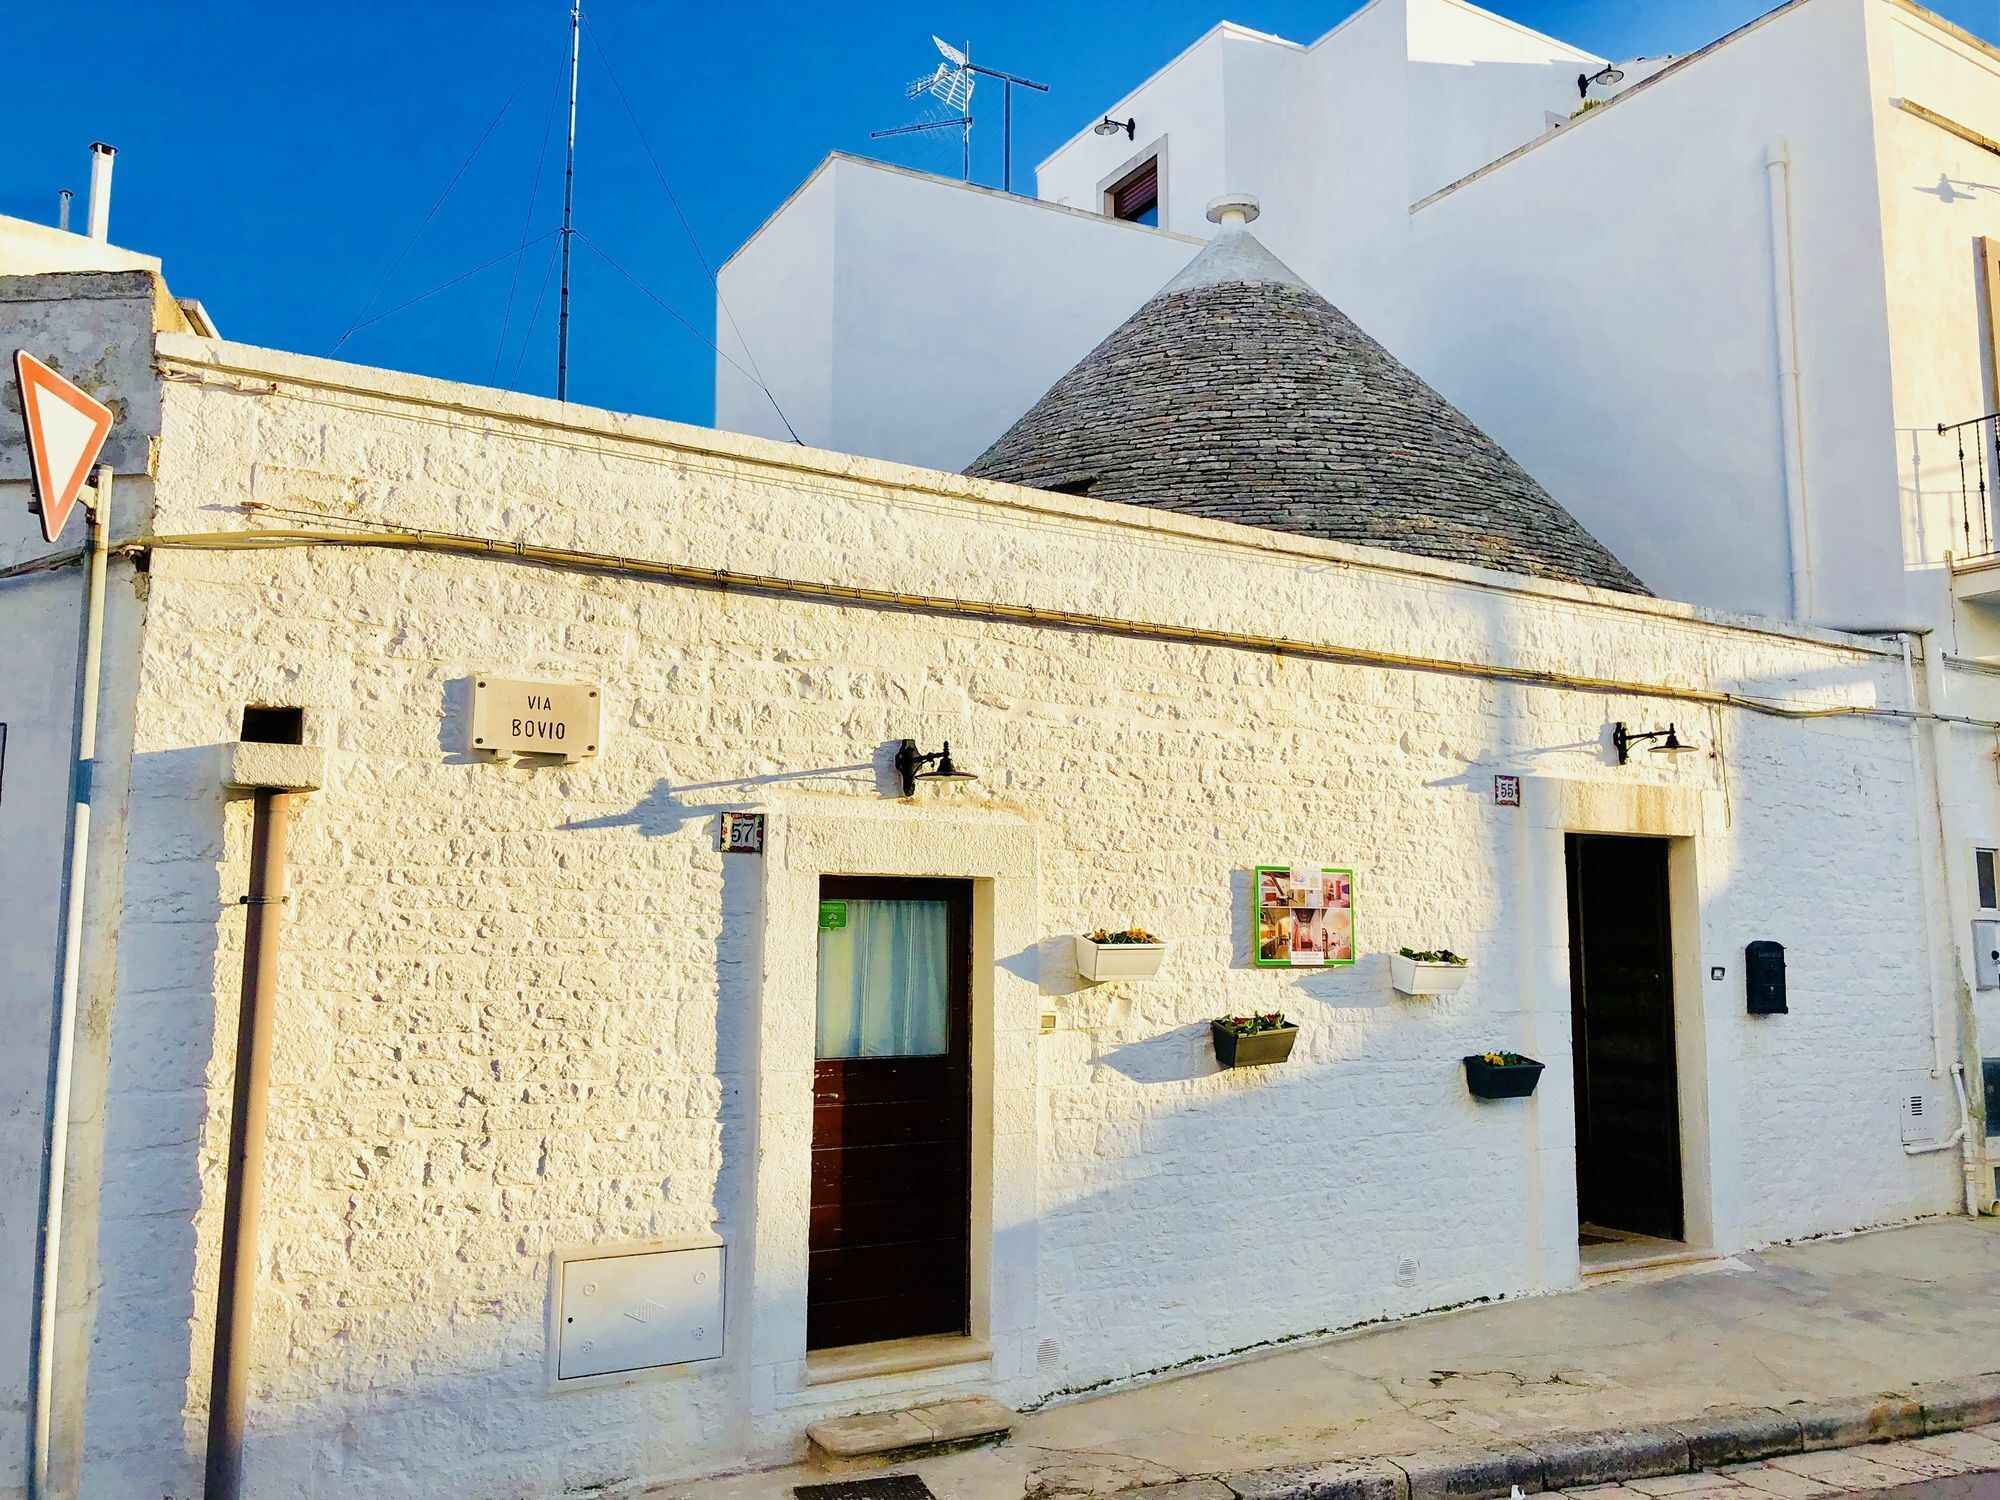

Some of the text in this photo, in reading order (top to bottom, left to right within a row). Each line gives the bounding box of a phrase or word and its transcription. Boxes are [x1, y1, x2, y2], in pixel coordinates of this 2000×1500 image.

[527, 695, 552, 711] VIA
[512, 719, 566, 740] BOVIO
[1500, 782, 1514, 798] 55
[731, 822, 754, 843] 57
